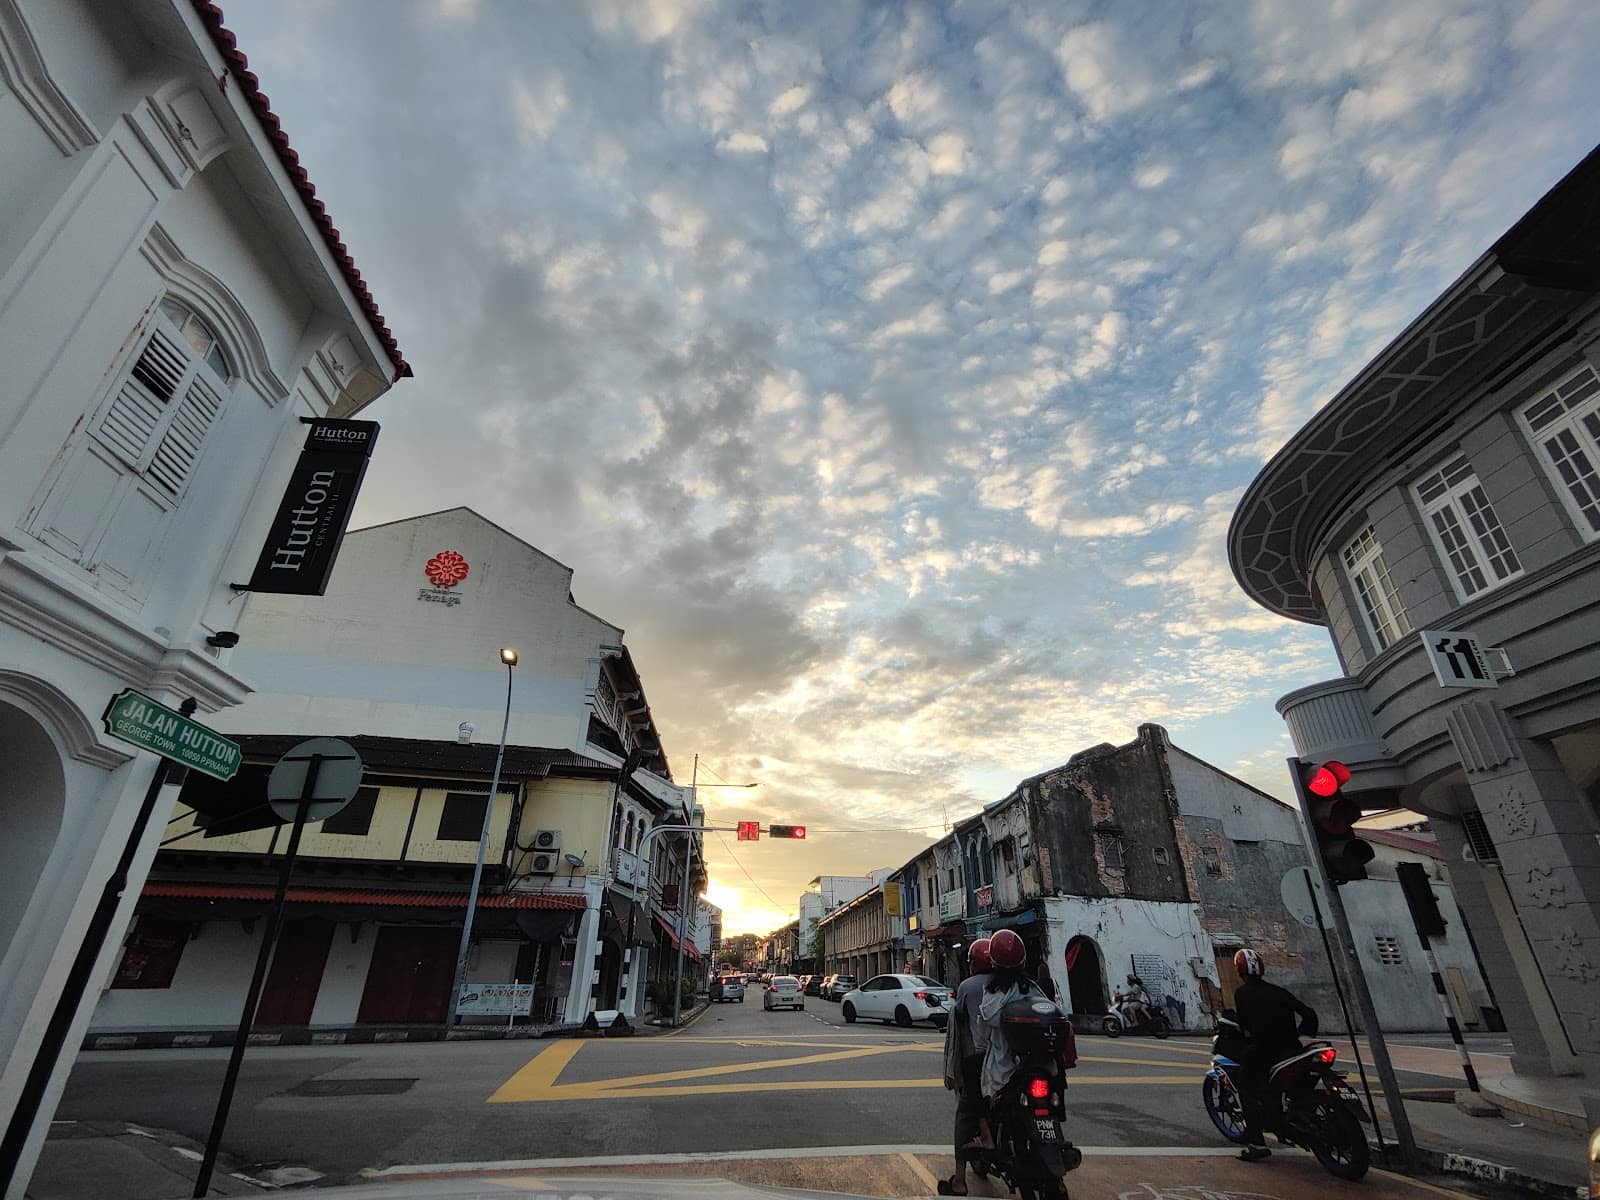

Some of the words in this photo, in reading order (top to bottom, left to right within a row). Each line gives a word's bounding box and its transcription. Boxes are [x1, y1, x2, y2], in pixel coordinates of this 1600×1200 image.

[314, 427, 367, 440] Hutton
[269, 470, 336, 572] Hutton
[116, 720, 152, 741] GEORGE
[153, 736, 177, 752] TOWN
[122, 700, 179, 737] JALAN
[179, 725, 237, 764] HUTTON
